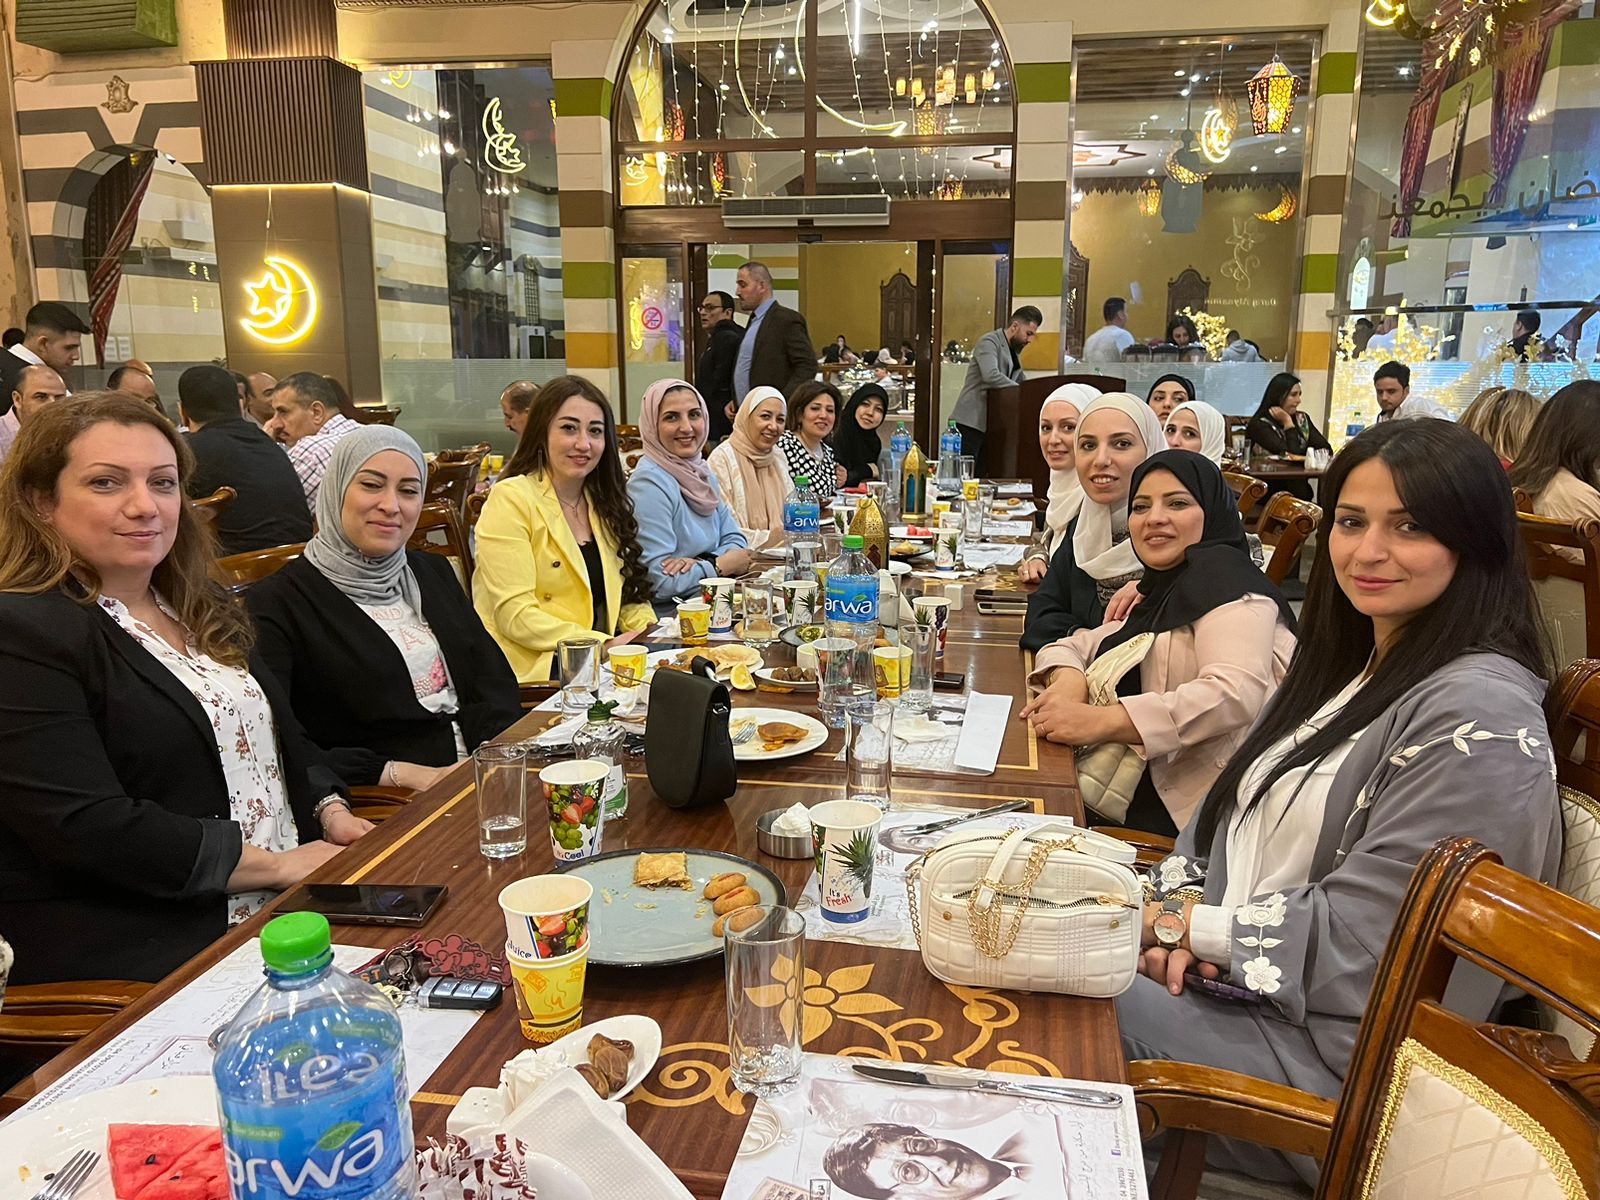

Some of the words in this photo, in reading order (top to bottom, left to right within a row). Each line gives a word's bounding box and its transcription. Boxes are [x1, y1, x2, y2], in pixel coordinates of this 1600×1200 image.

[824, 597, 872, 614] arwa
[829, 888, 841, 897] It's
[826, 894, 852, 907] Fresh
[226, 1129, 385, 1196] arwa
